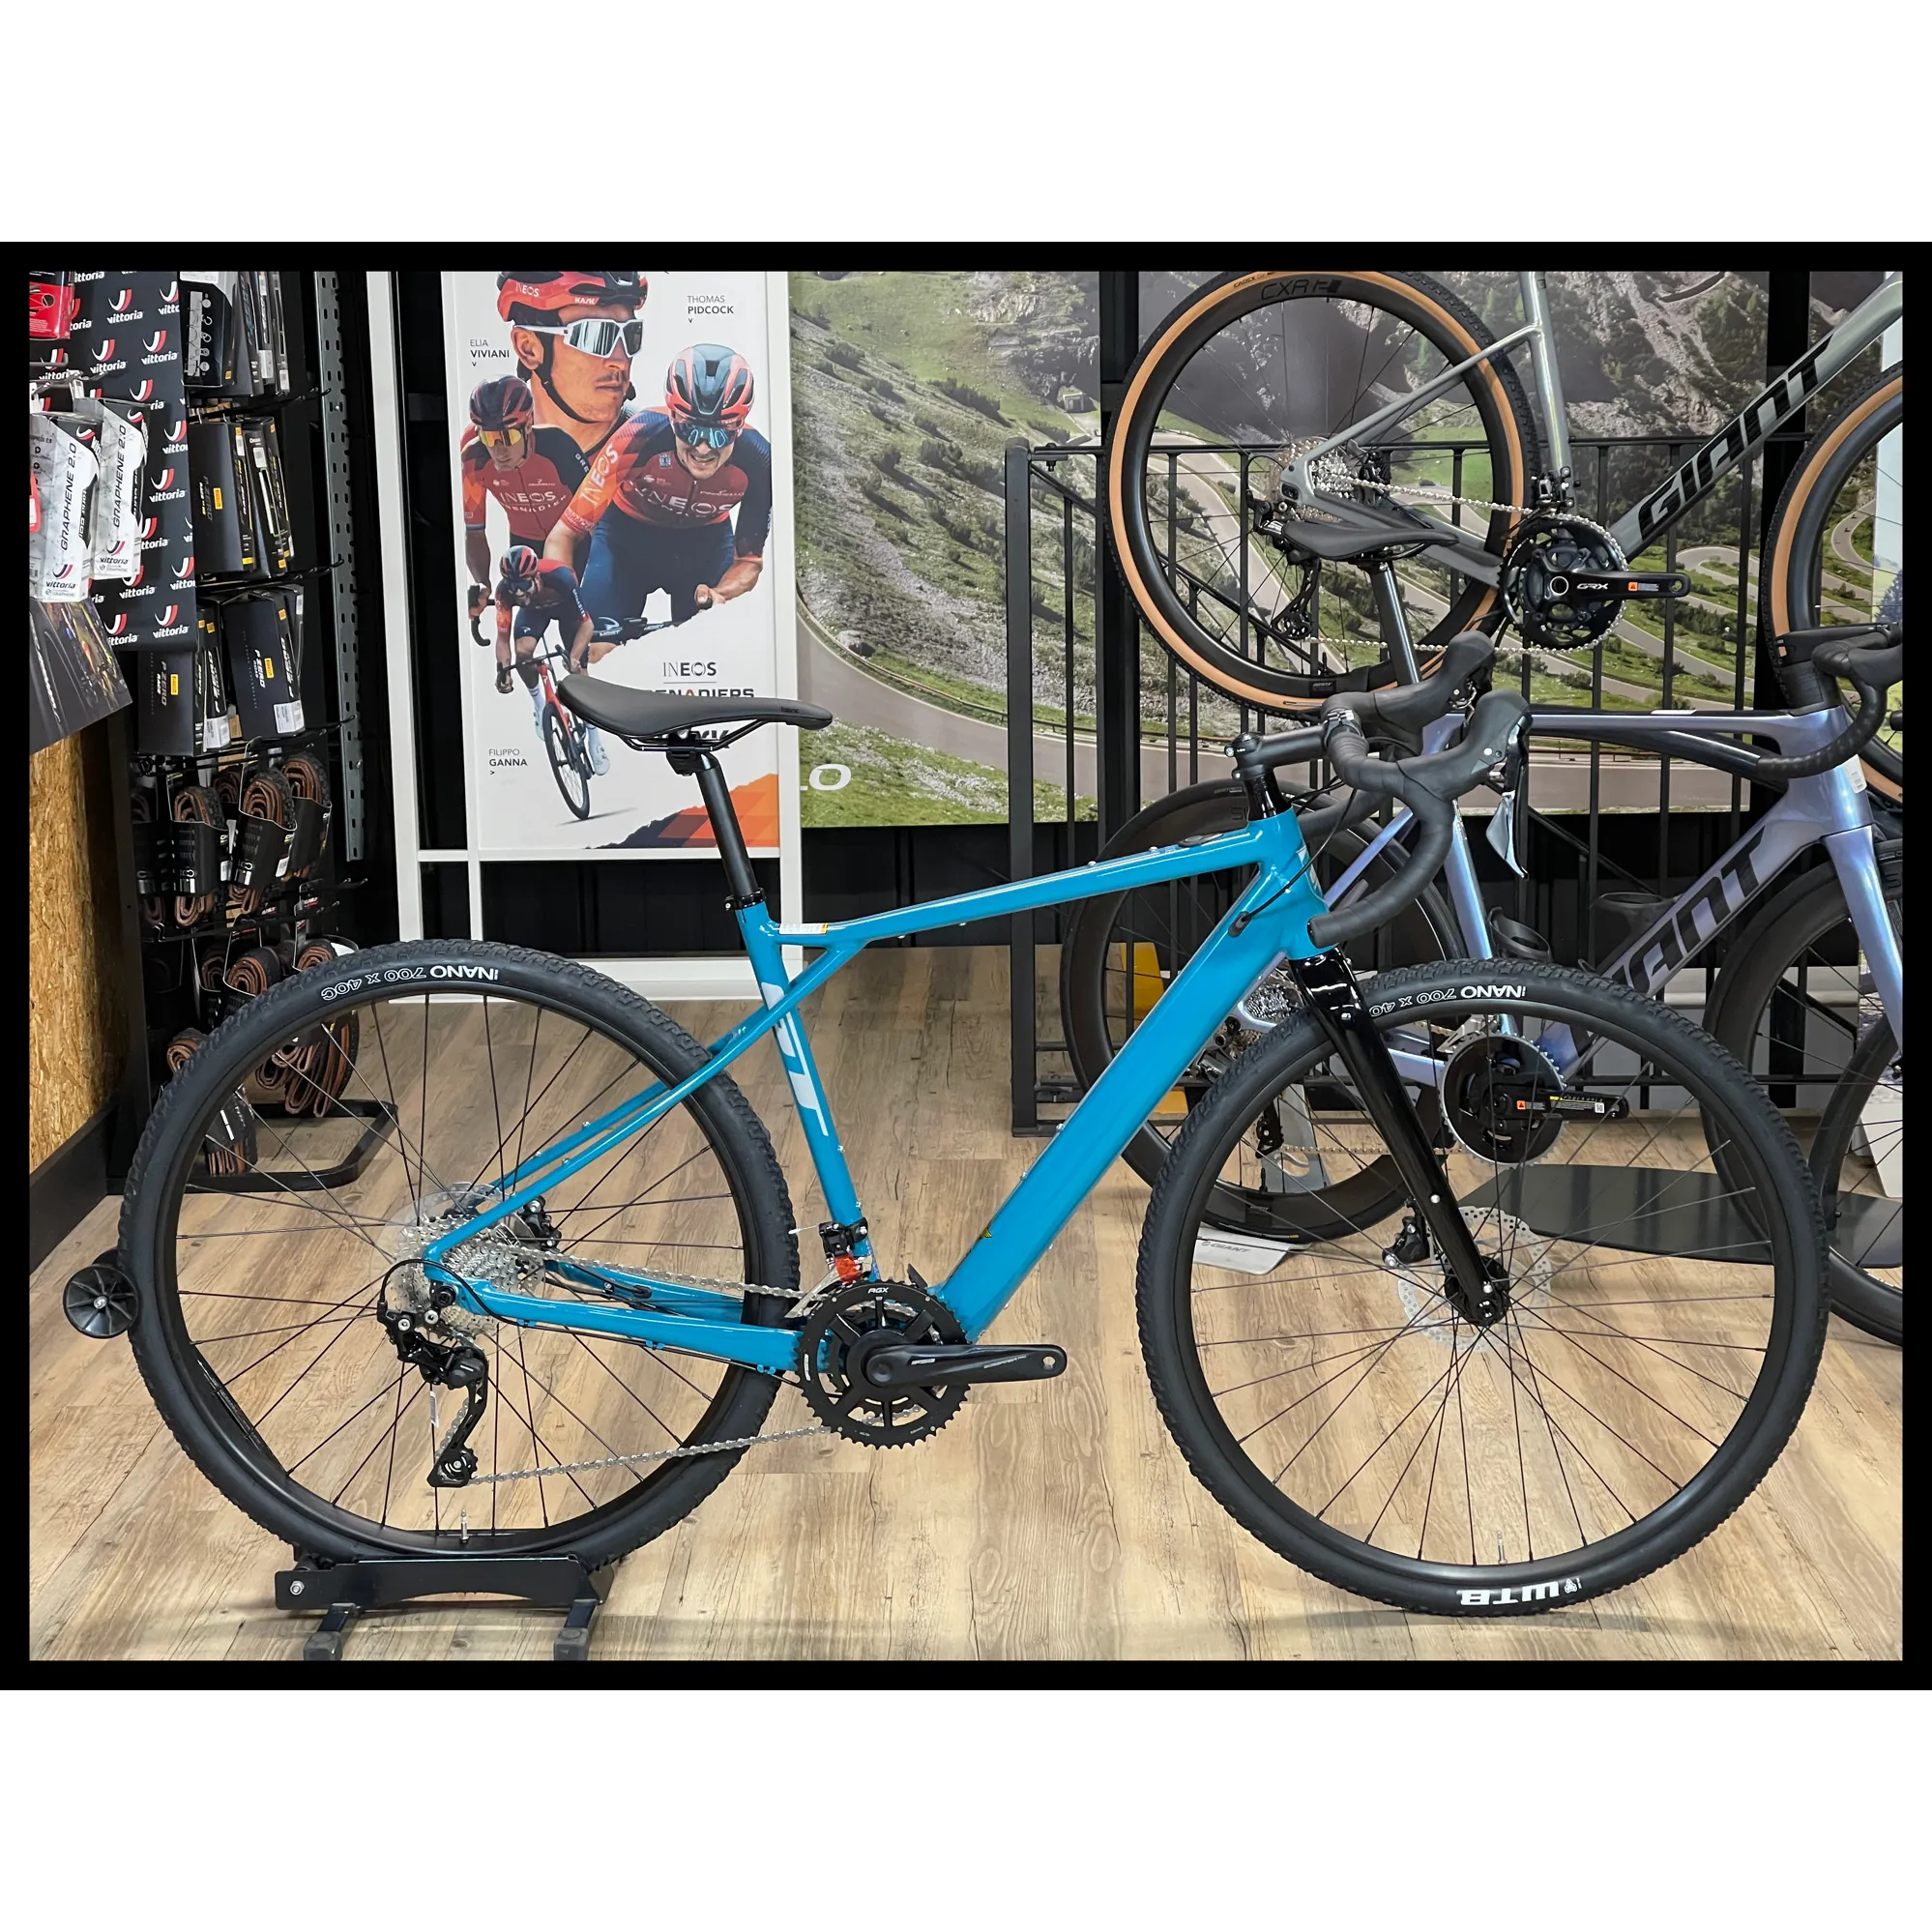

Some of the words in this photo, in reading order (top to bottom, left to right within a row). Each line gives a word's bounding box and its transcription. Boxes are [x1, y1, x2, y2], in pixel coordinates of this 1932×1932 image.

[74, 271, 105, 282] ittoria
[515, 282, 541, 297] INEOS
[574, 296, 597, 306] KASK
[687, 295, 725, 304] THOMAS
[158, 304, 180, 315] vitto
[688, 305, 735, 314] PIDCOCK
[106, 310, 144, 324] vittoria
[70, 319, 93, 331] toria
[141, 352, 178, 366] vittoria
[470, 349, 511, 359] VIVIANI
[39, 369, 72, 380] vittori
[90, 361, 128, 374] vittoria
[118, 424, 127, 451] 2.0
[1638, 333, 1834, 542] GIANT
[161, 443, 189, 454] vitto
[580, 444, 620, 507] INEOS
[60, 473, 76, 551] GRAPHENE
[68, 442, 77, 470] 2.0
[112, 455, 126, 528] GRAPHENE
[149, 489, 187, 503] vittoria
[500, 491, 556, 503] INEOS
[141, 538, 170, 550] ttoria
[45, 581, 76, 590] vittoria
[169, 579, 195, 591] vitto
[119, 586, 157, 600] vittoria
[152, 625, 190, 639] vittoria
[107, 633, 139, 646] ittoria
[662, 661, 717, 677] INEOS
[488, 758, 528, 767] GANNA
[1610, 825, 1766, 994] ANT
[384, 968, 427, 982] 700
[429, 965, 495, 980] NANO
[321, 979, 363, 1001] 40C
[1417, 988, 1457, 1005] 700
[1460, 985, 1522, 999] NANO
[1369, 1002, 1396, 1017] 40
[1456, 1581, 1561, 1605] WTB
